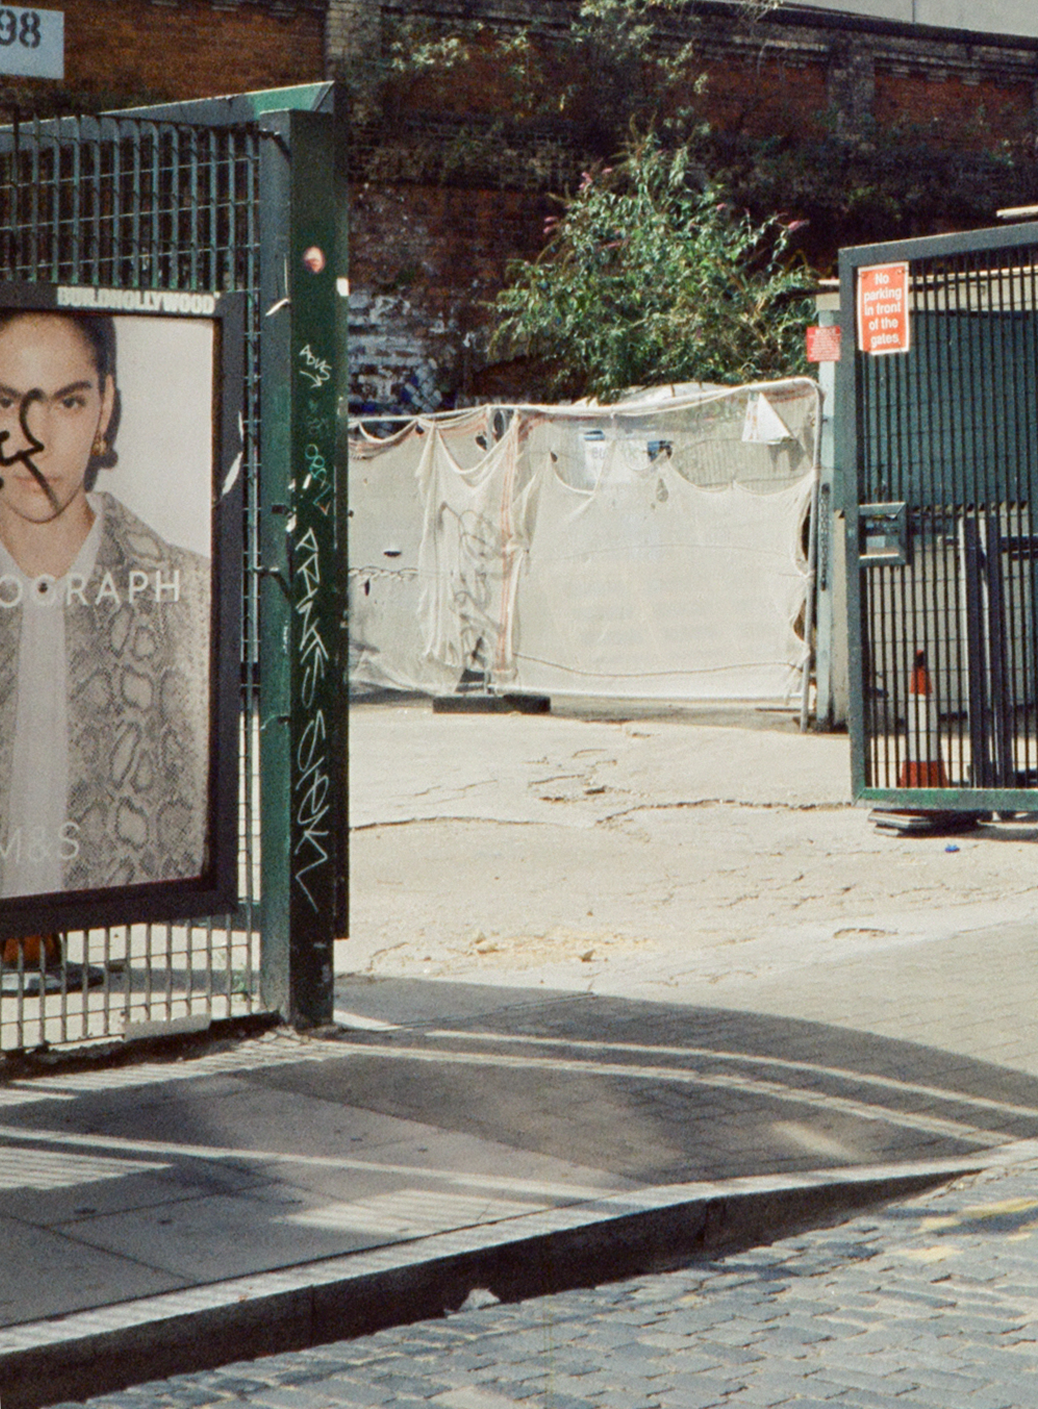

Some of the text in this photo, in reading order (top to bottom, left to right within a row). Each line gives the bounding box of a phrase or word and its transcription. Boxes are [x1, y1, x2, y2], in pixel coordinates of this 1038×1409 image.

[874, 273, 889, 285] No
[864, 287, 902, 304] parking
[864, 302, 901, 316] in front
[868, 317, 898, 331] of the
